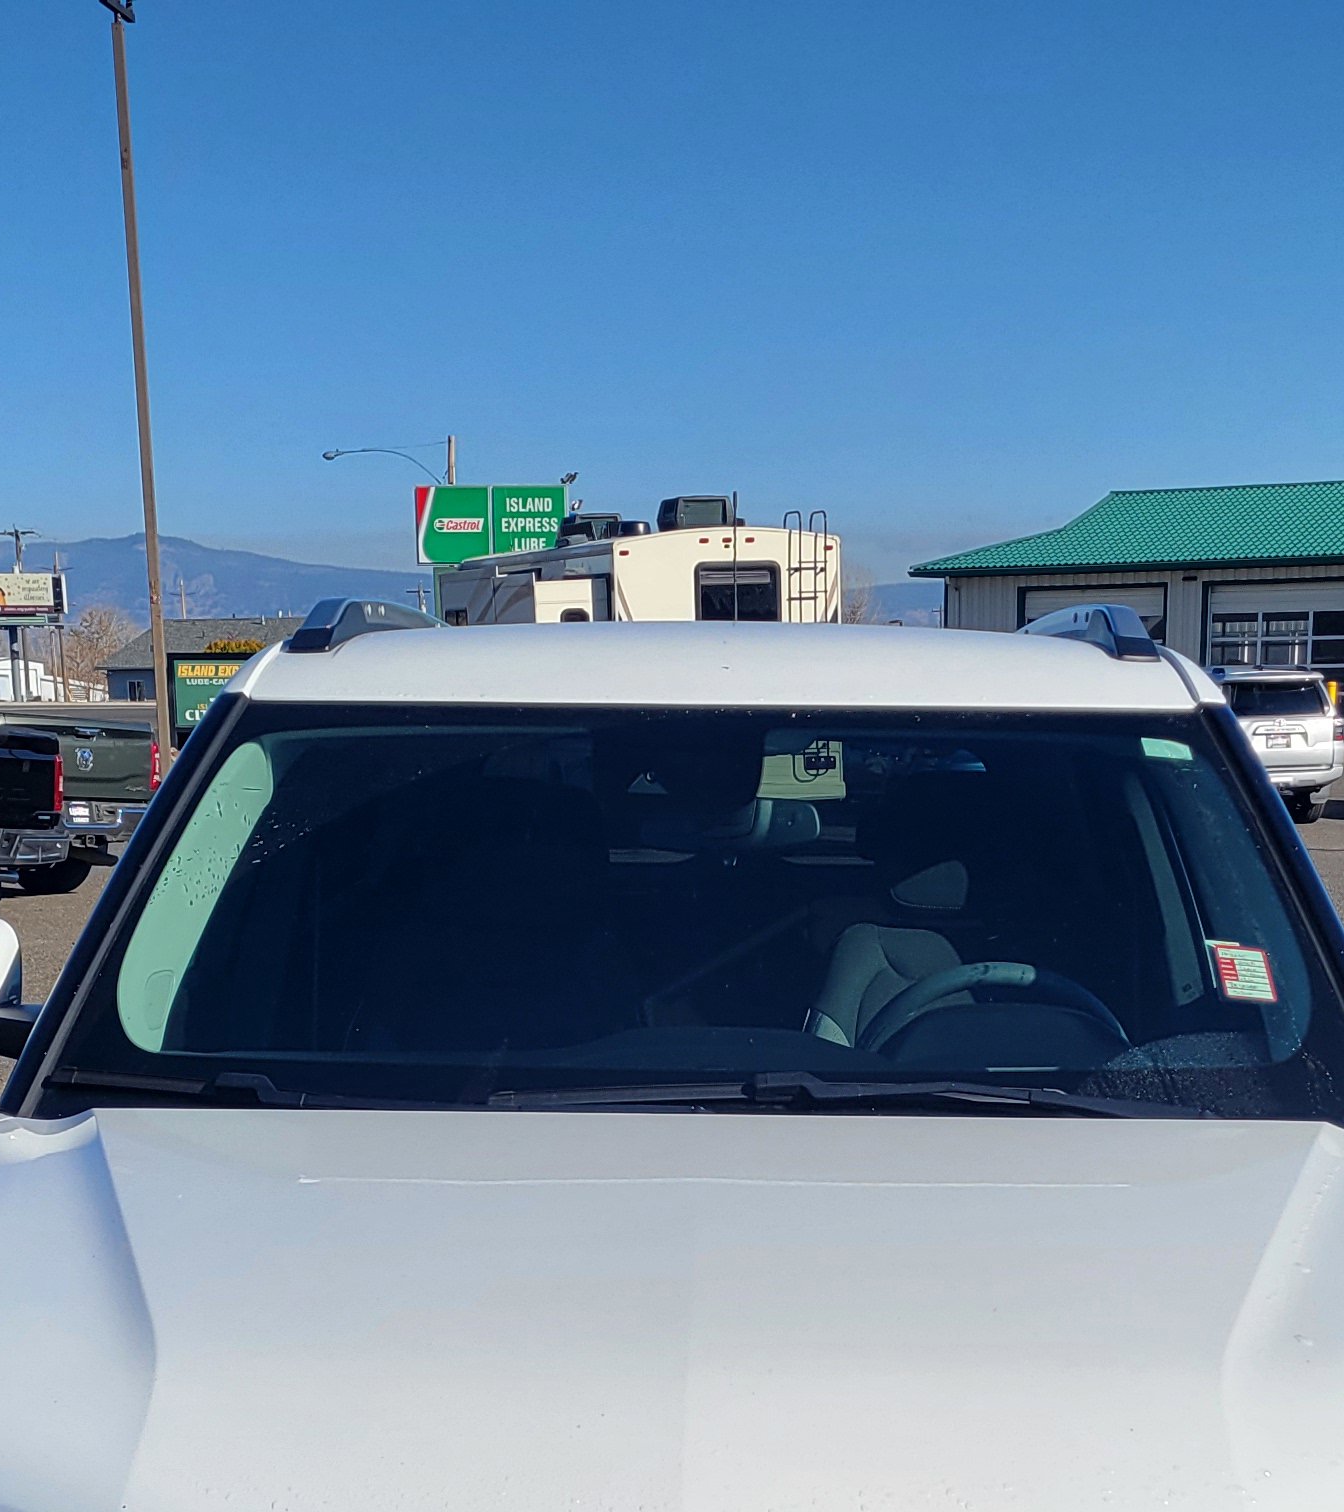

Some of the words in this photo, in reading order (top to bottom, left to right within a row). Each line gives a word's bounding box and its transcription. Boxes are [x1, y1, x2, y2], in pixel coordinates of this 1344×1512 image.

[506, 498, 552, 511] ISLAND
[446, 520, 480, 530] Castrol
[501, 518, 559, 532] EXPRESS
[514, 538, 546, 551] LUBE
[178, 665, 216, 676] ISLAND
[218, 665, 240, 676] EXP
